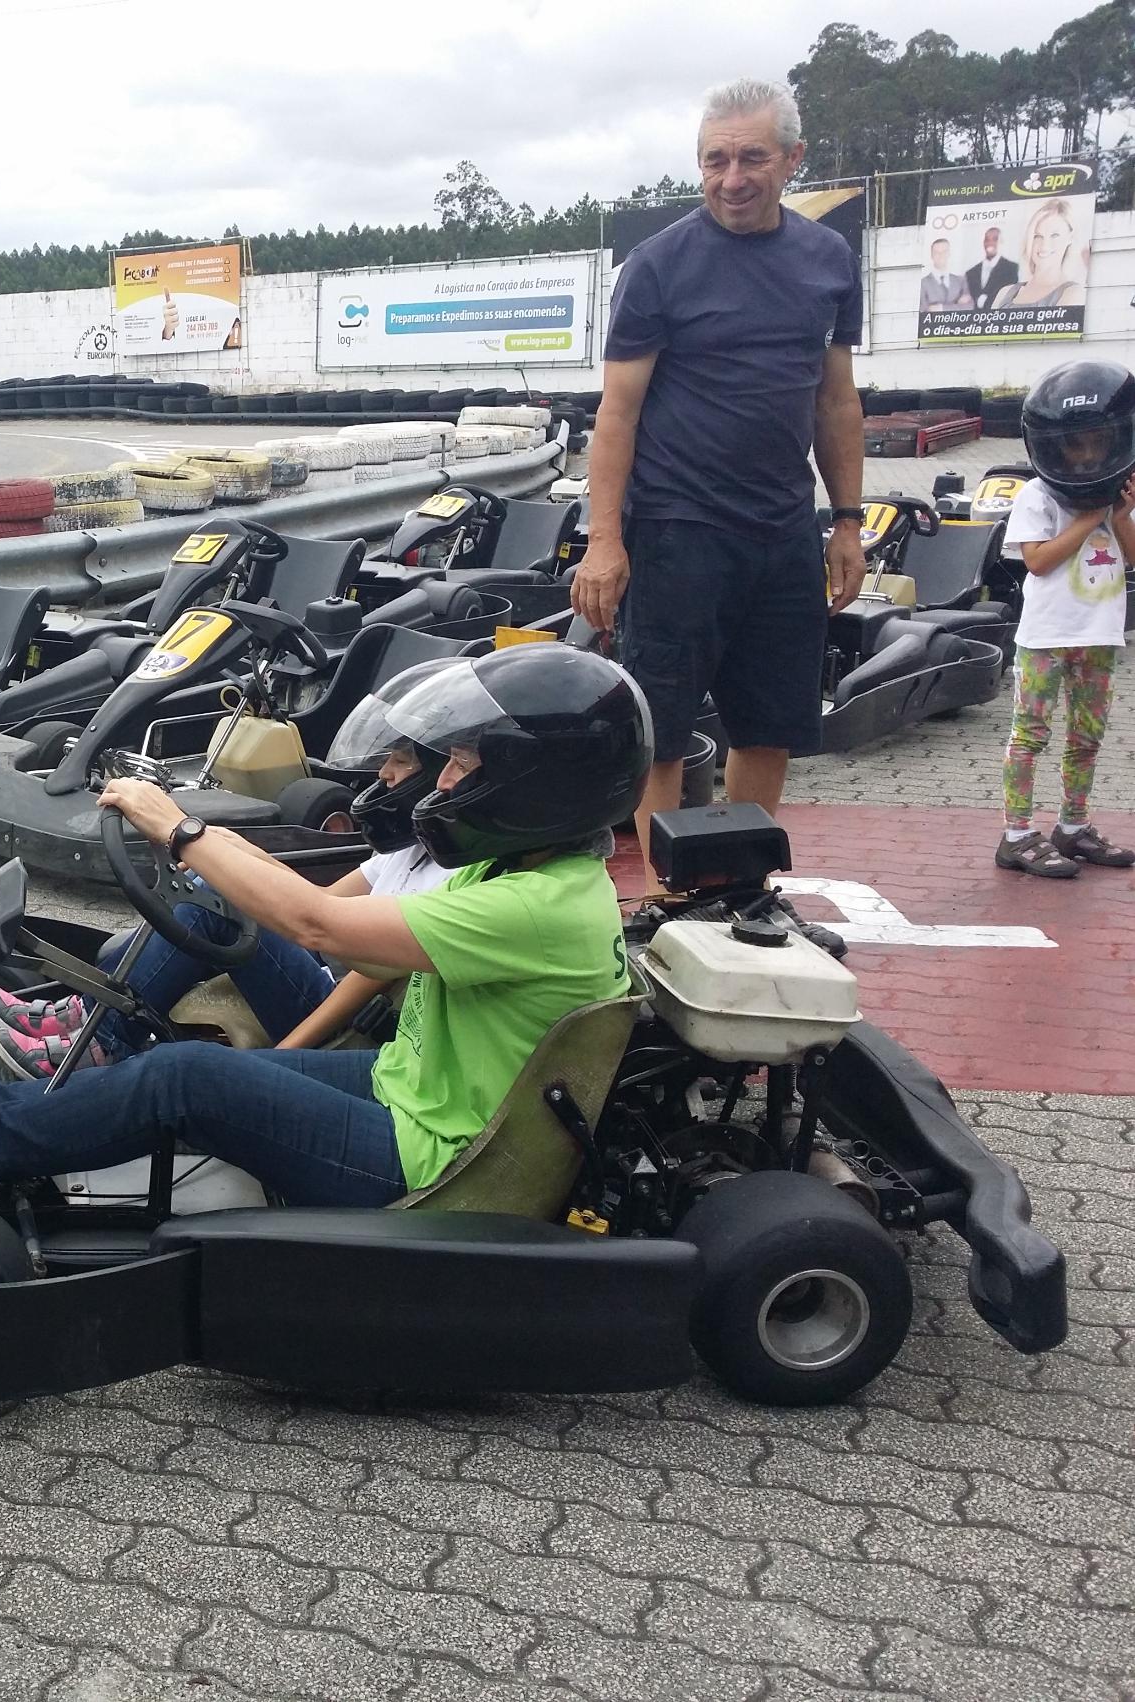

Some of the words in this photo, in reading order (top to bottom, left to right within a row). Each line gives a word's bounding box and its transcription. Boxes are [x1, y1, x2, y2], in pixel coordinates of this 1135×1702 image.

[1044, 170, 1077, 191] apri
[933, 183, 994, 197] www.apri.pt
[962, 209, 1008, 222] ARTSOFT
[435, 283, 440, 294] A
[476, 283, 485, 292] no
[487, 280, 518, 292] Coração
[519, 278, 533, 289] das
[535, 277, 575, 290] Empresas
[390, 311, 435, 324] Preparamos
[442, 308, 483, 322] Expedimos
[484, 311, 493, 319] as
[494, 310, 512, 319] suas
[514, 305, 567, 319] encomendas
[924, 313, 932, 323] A
[934, 312, 971, 323] melhor
[973, 310, 1006, 324] opção
[1008, 311, 1034, 324] para
[1037, 307, 1067, 322] gerir
[923, 327, 931, 335] o
[933, 323, 982, 335] dia-a-dia
[984, 323, 1000, 333] da
[1001, 324, 1025, 333] sua
[1026, 322, 1079, 334] empresa
[979, 479, 1017, 498] 12
[176, 537, 225, 559] 27
[161, 614, 216, 650] 17
